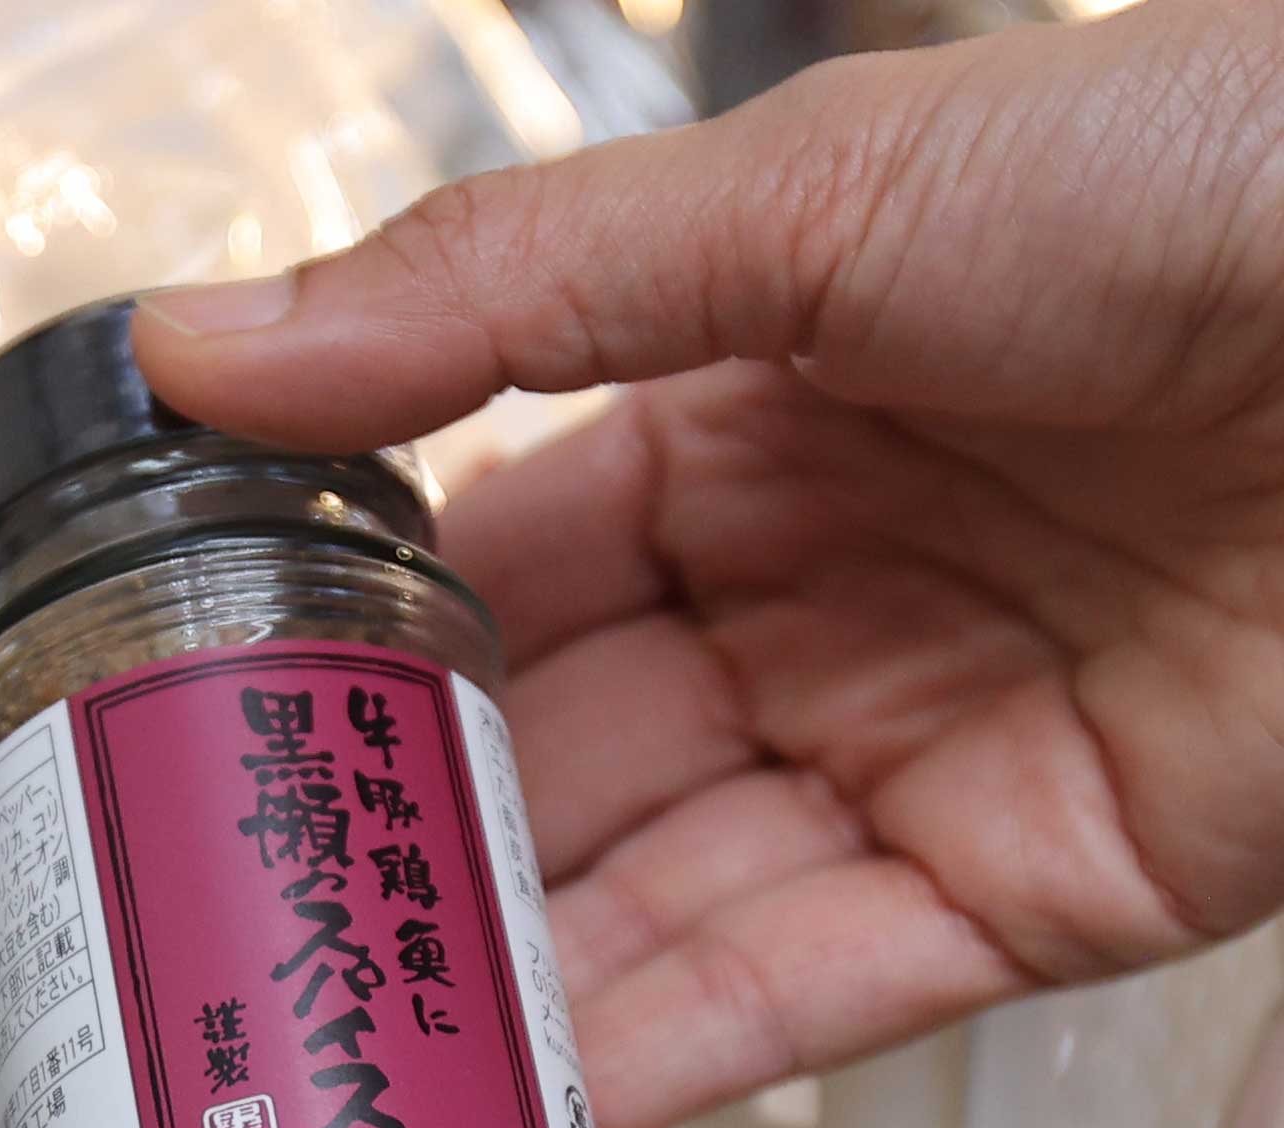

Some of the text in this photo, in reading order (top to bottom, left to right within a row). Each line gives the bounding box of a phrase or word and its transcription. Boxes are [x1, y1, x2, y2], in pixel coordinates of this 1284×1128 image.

[347, 685, 461, 1037] 牛豚鶏魚に
